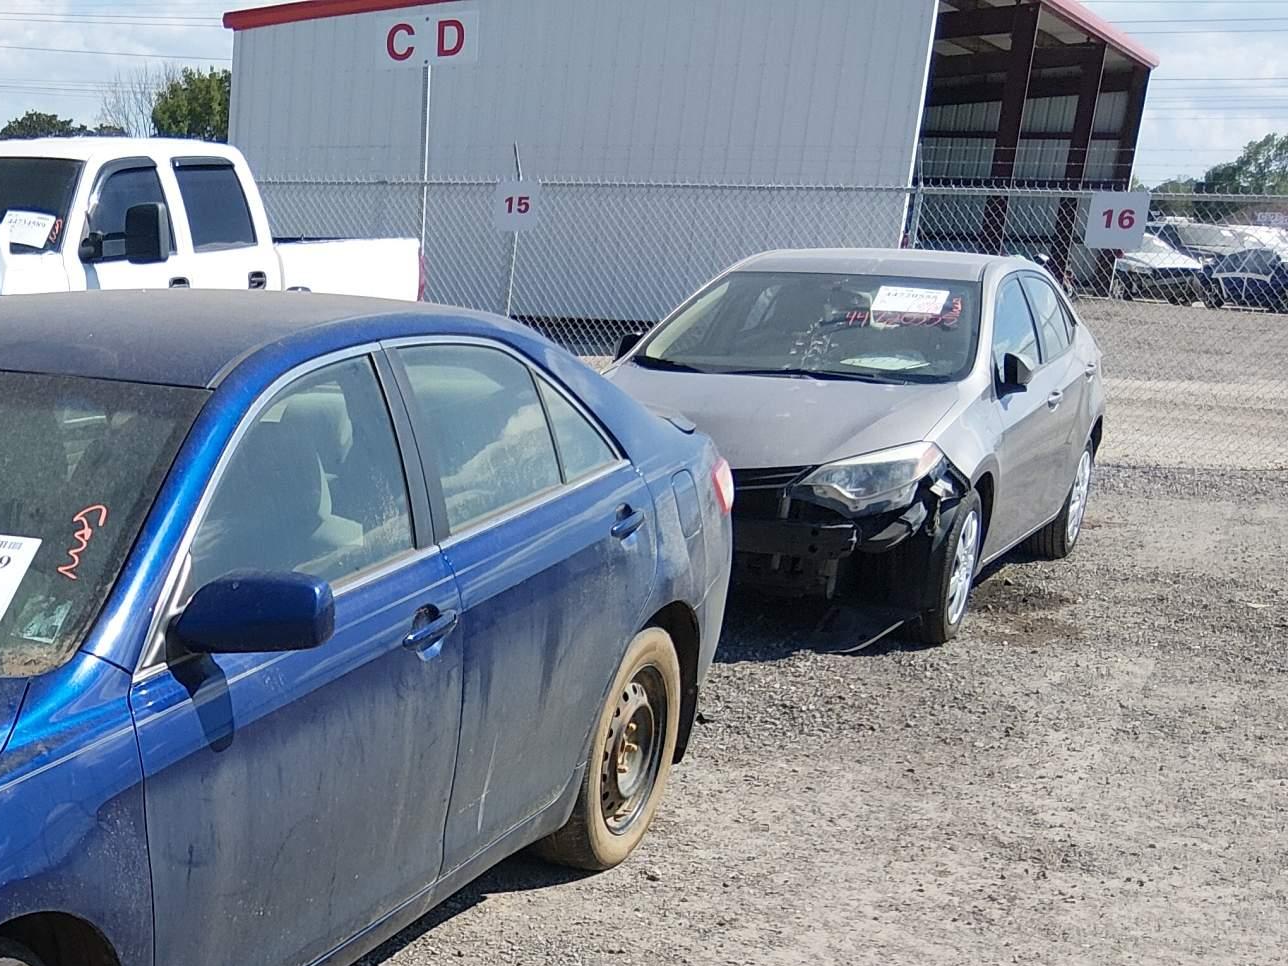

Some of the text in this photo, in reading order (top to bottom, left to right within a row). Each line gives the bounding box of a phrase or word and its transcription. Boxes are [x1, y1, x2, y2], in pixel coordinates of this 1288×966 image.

[386, 19, 465, 62] C D
[504, 196, 530, 214] 15
[1101, 208, 1136, 230] 16
